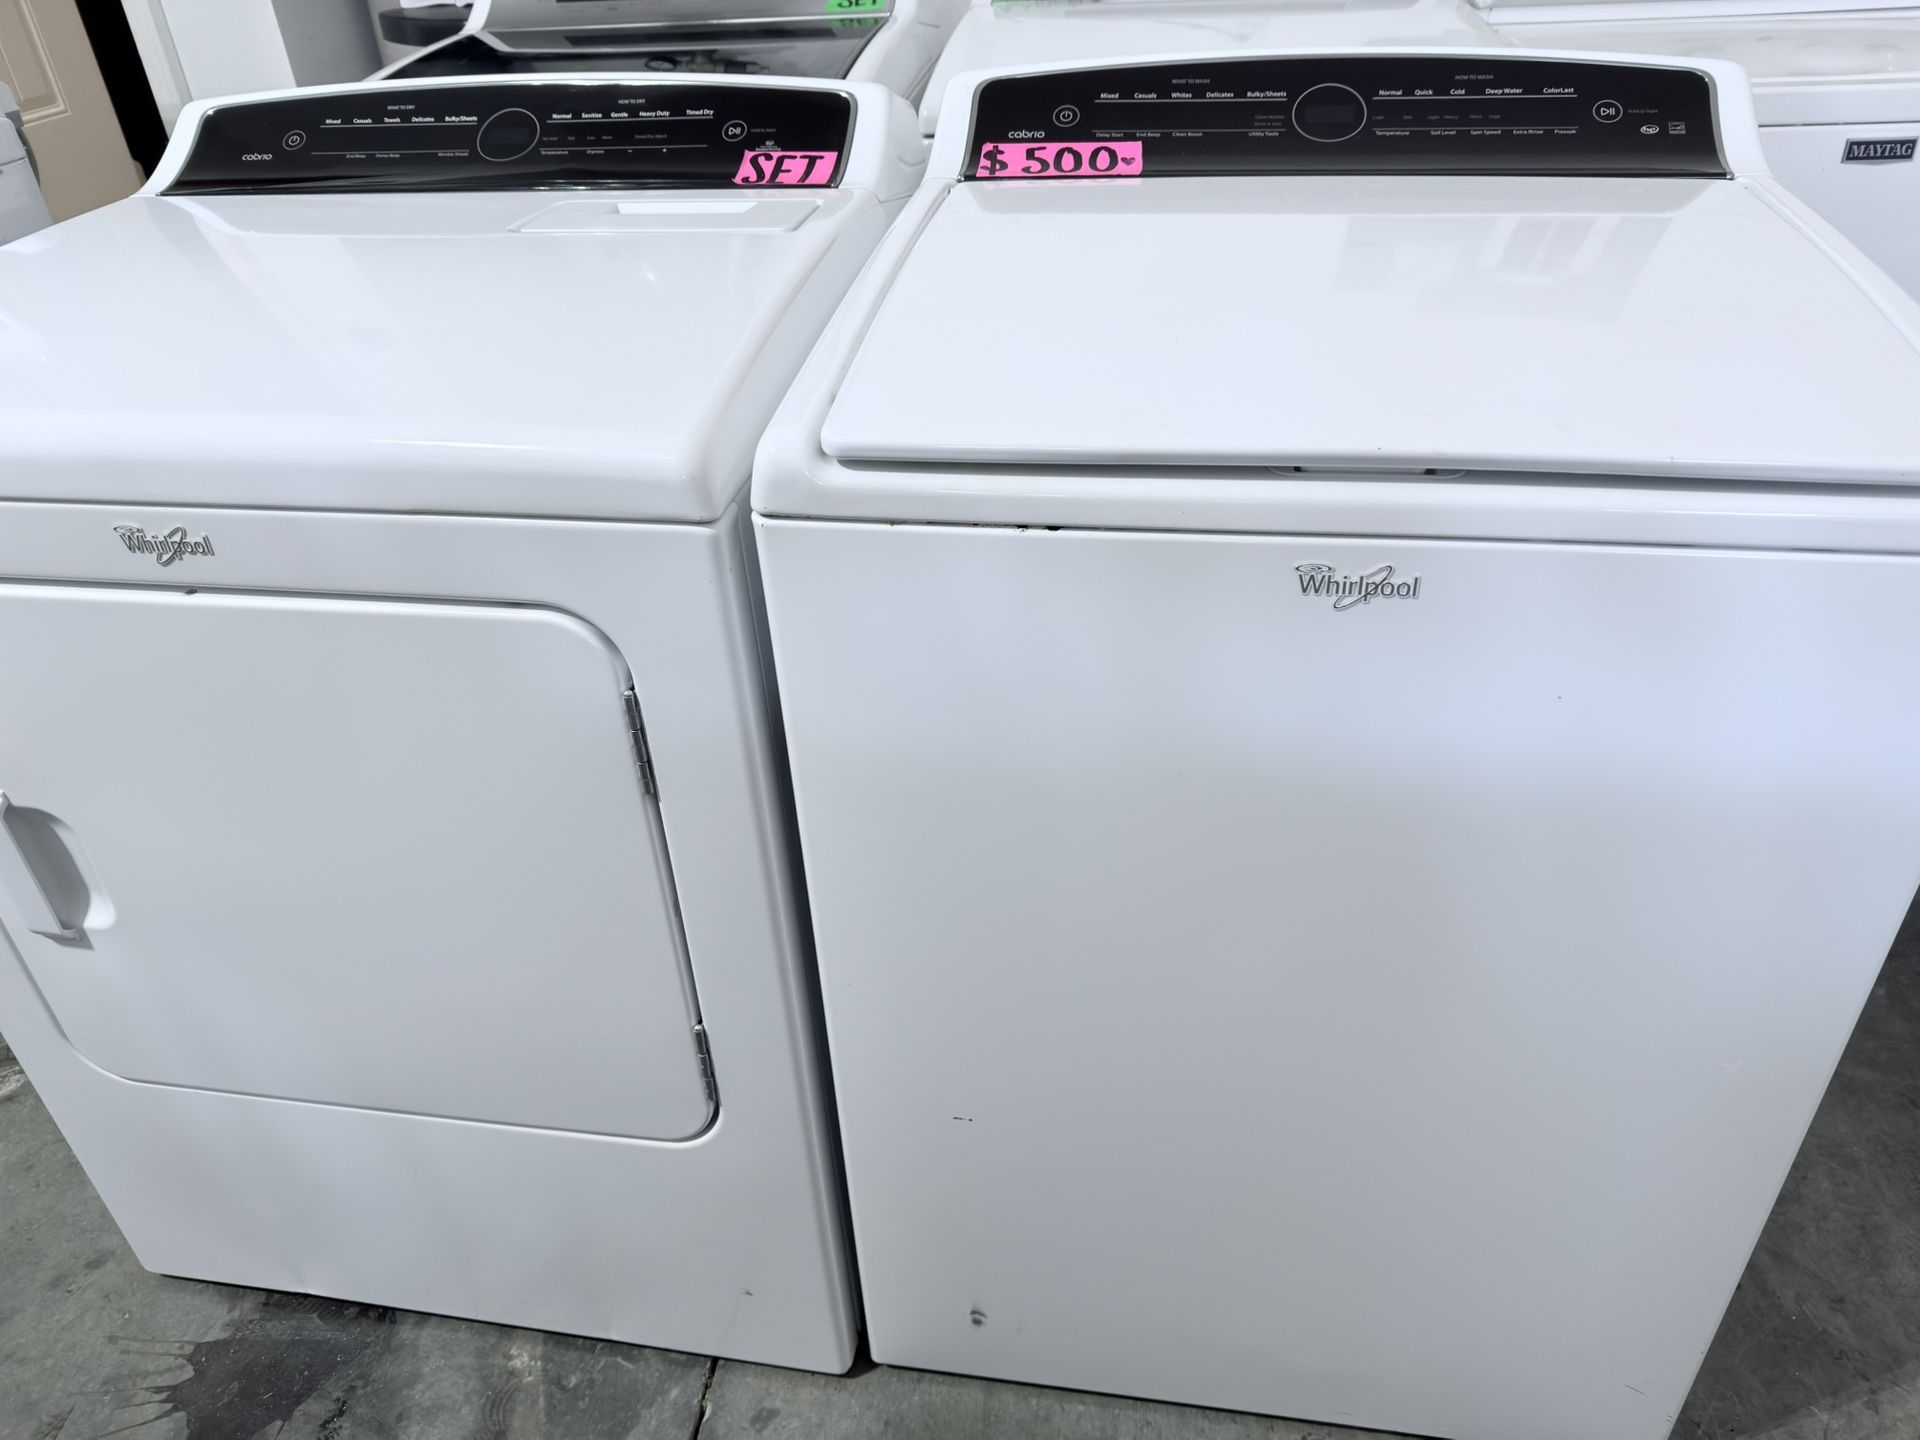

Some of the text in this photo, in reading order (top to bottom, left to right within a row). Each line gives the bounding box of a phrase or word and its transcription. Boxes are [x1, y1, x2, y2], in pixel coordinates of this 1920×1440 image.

[1485, 88, 1503, 96] Deep
[1008, 129, 1045, 139] cabrio
[242, 153, 272, 161] cabrio
[980, 145, 1119, 175] $ 500
[1848, 143, 1913, 158] MAYTAG
[741, 152, 825, 184] SET
[113, 526, 215, 567] Whirlpool
[1295, 563, 1420, 610] Whirlpool
